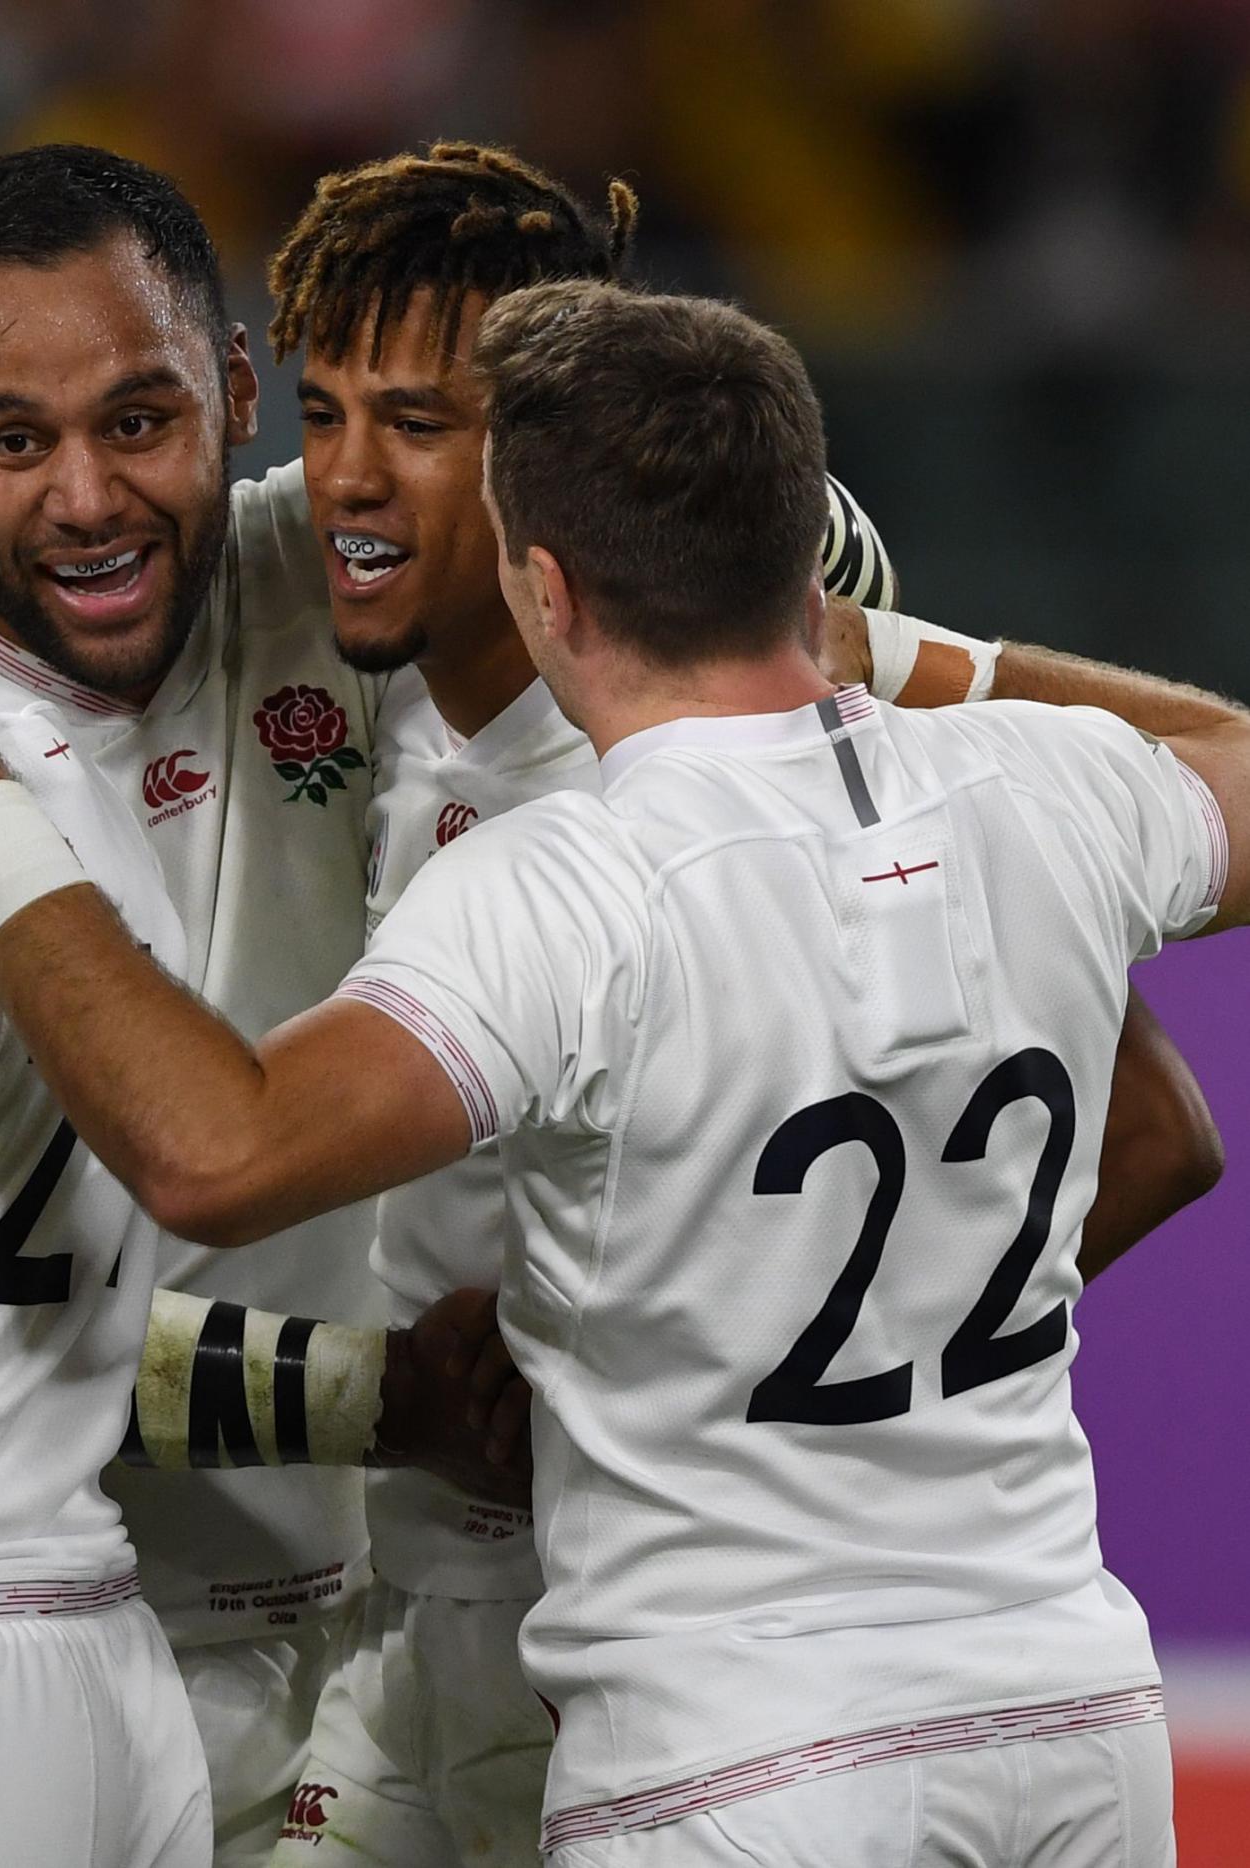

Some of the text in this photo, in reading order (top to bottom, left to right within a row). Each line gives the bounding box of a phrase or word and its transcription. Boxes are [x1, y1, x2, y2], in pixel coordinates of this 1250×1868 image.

[147, 784, 217, 828] canterbury
[746, 1047, 1076, 1425] 22
[210, 1579, 273, 1595] England
[210, 1597, 245, 1611] 19th
[252, 1591, 309, 1608] October
